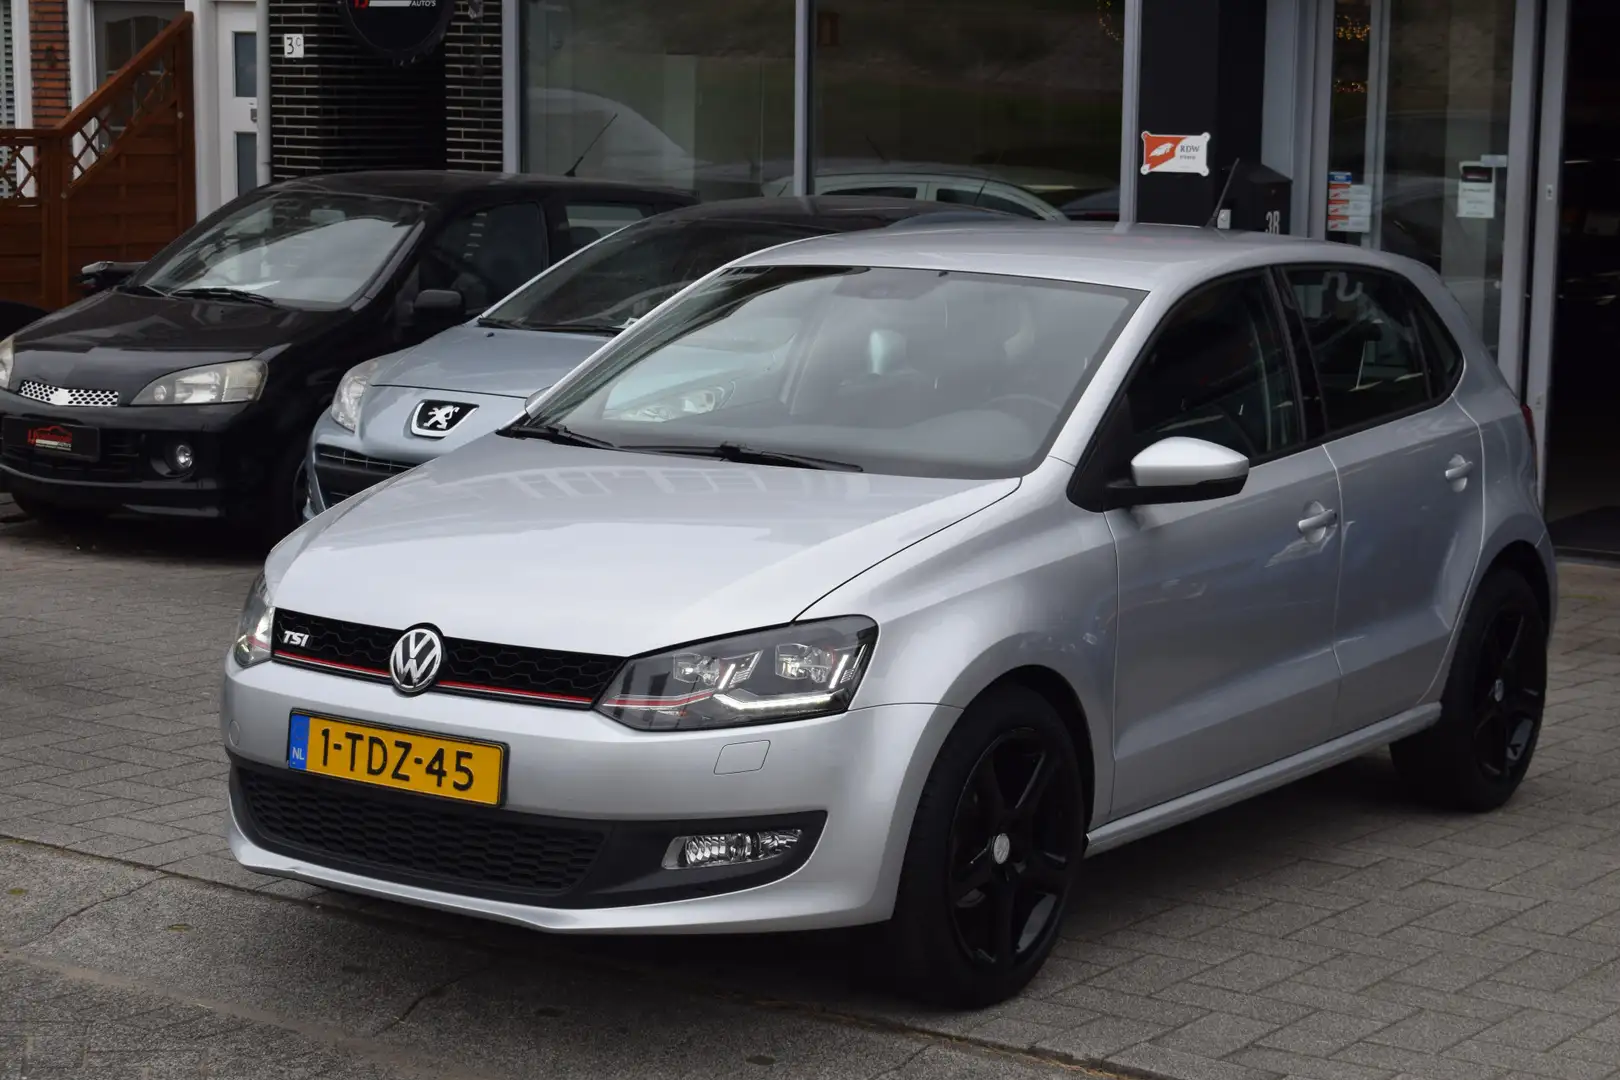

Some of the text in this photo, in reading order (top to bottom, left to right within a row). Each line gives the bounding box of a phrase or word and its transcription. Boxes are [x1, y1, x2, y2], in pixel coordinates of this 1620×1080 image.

[1180, 145, 1200, 153] RDW
[283, 630, 309, 647] TSI
[292, 747, 305, 761] NL
[321, 728, 474, 792] 1-TDZ-45
